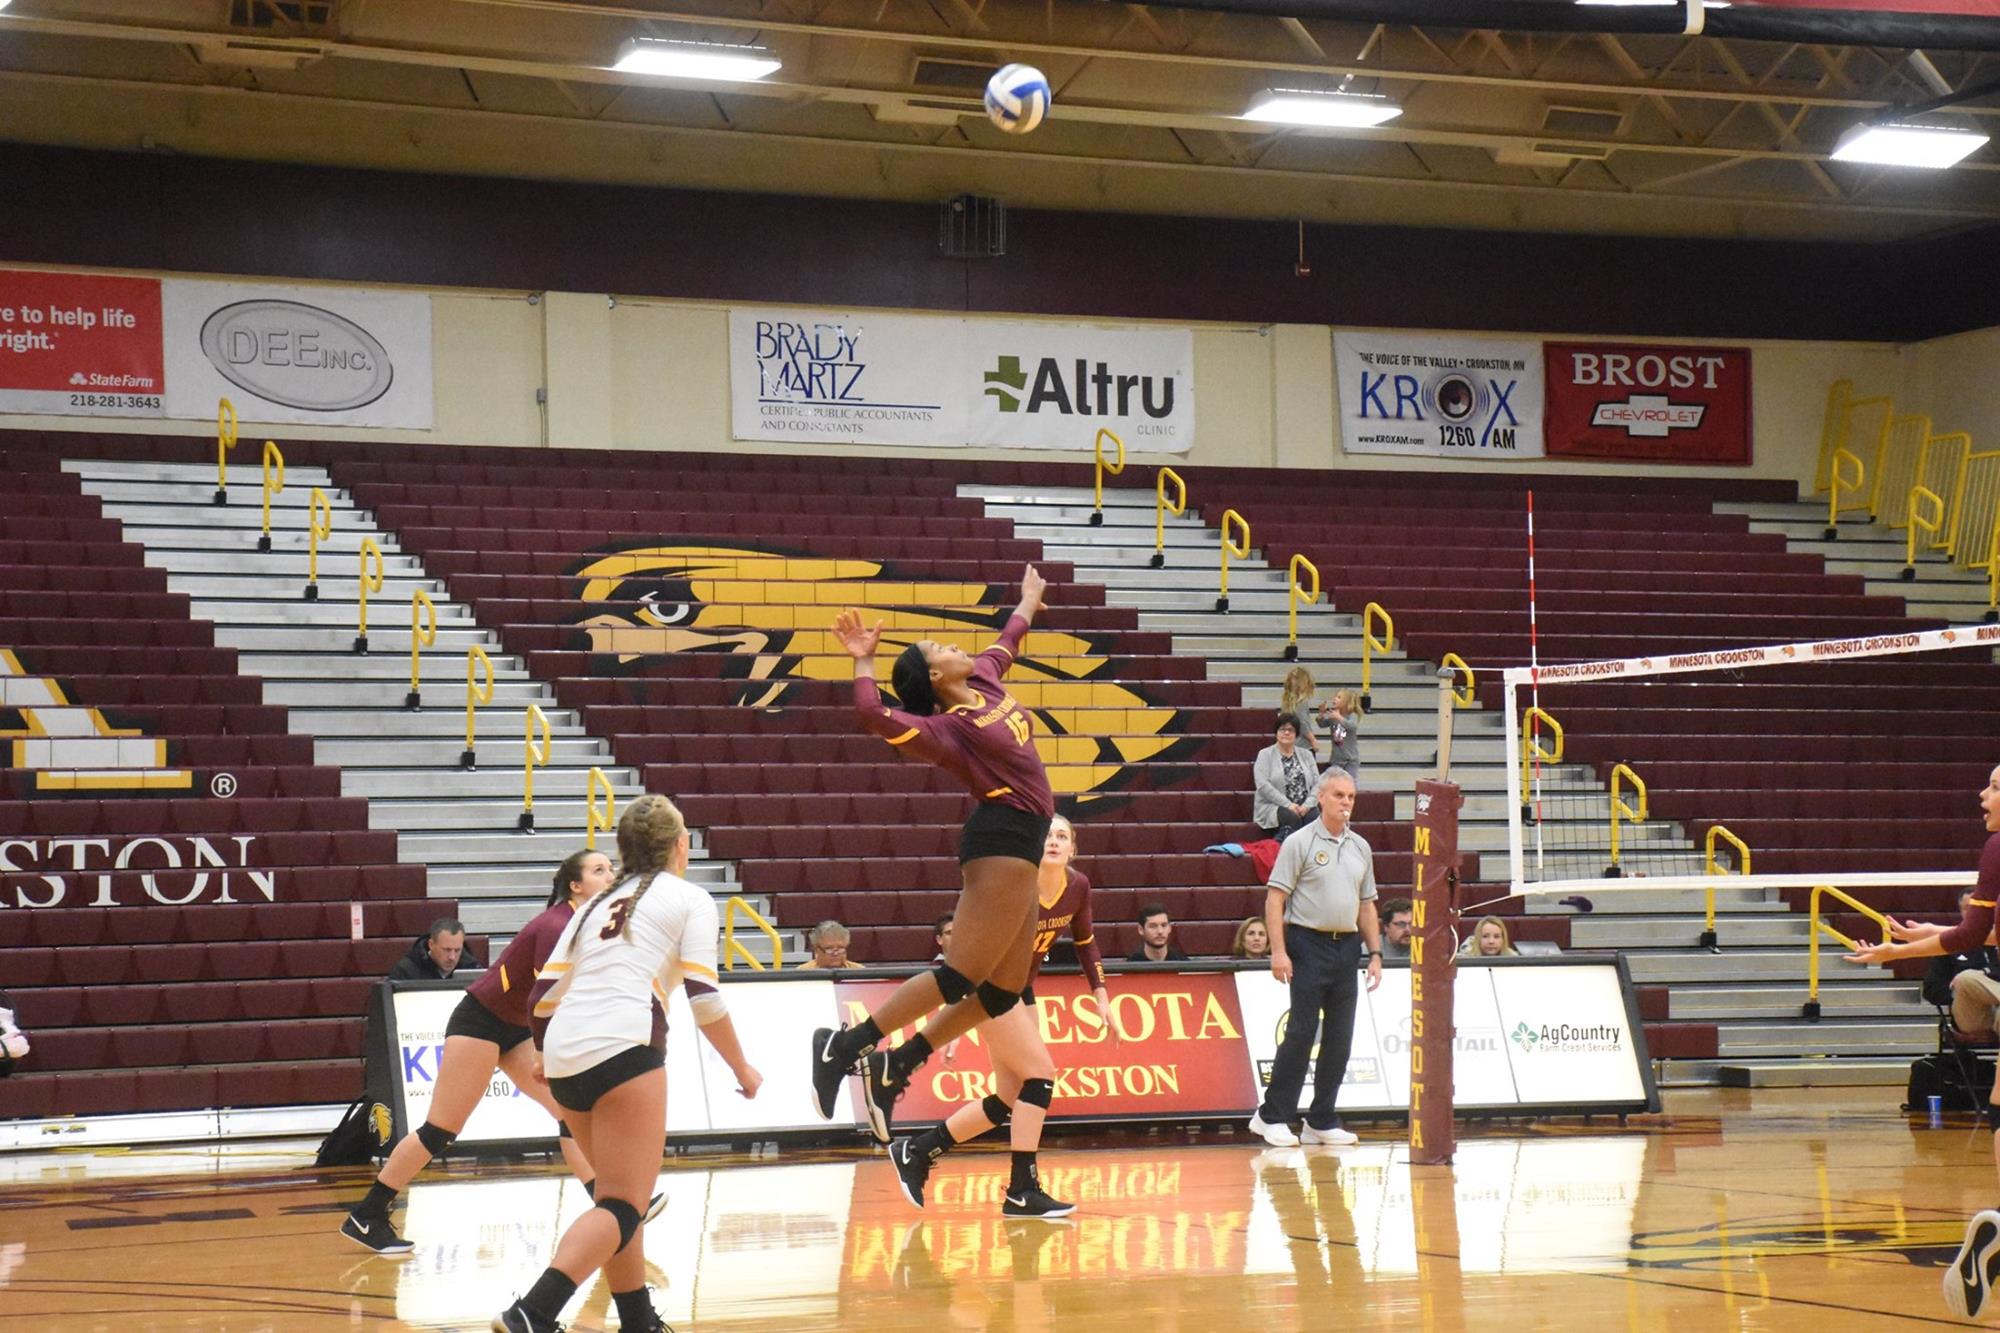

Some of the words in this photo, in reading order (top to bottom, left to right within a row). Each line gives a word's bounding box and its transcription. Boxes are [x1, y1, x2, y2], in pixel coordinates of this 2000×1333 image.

[21, 305, 43, 323] to
[50, 305, 96, 330] help
[103, 308, 136, 328] life
[227, 327, 321, 368] DEE
[321, 349, 372, 371] INC.
[756, 321, 864, 362] BRADY
[1359, 352, 1374, 364] THE
[1376, 353, 1400, 366] VOICE
[1401, 355, 1411, 366] OF
[1413, 355, 1428, 367] THE
[1430, 356, 1458, 369] VALLEY
[1571, 353, 1725, 388] BROST
[89, 372, 122, 387] State
[122, 376, 153, 388] Farm
[756, 358, 867, 401] MARTZ
[1026, 357, 1174, 419] Altru
[70, 394, 160, 409] 218-281-3643
[760, 420, 786, 430] AND
[854, 409, 933, 421] ACCOUNTANTS
[1600, 408, 1698, 422] CHEVROLET
[1137, 424, 1176, 436] CLINIC
[1358, 434, 1425, 446] www.KROXAM.com
[1439, 425, 1475, 447] 1260
[1492, 428, 1516, 449] AM
[1813, 640, 1864, 656] MINNESOTA
[1865, 635, 1920, 652] CROOKSTON
[1669, 653, 1713, 668] MINNESOTA
[1714, 649, 1765, 665] CROOKSTON
[1539, 666, 1579, 679] MINNESOTA
[1580, 661, 1625, 676] CROOKSTON
[599, 896, 636, 940] 3
[1410, 826, 1431, 1149] MINNESOTA
[1540, 1024, 1620, 1044] AgCountry
[931, 1064, 1180, 1104] CRKSTON
